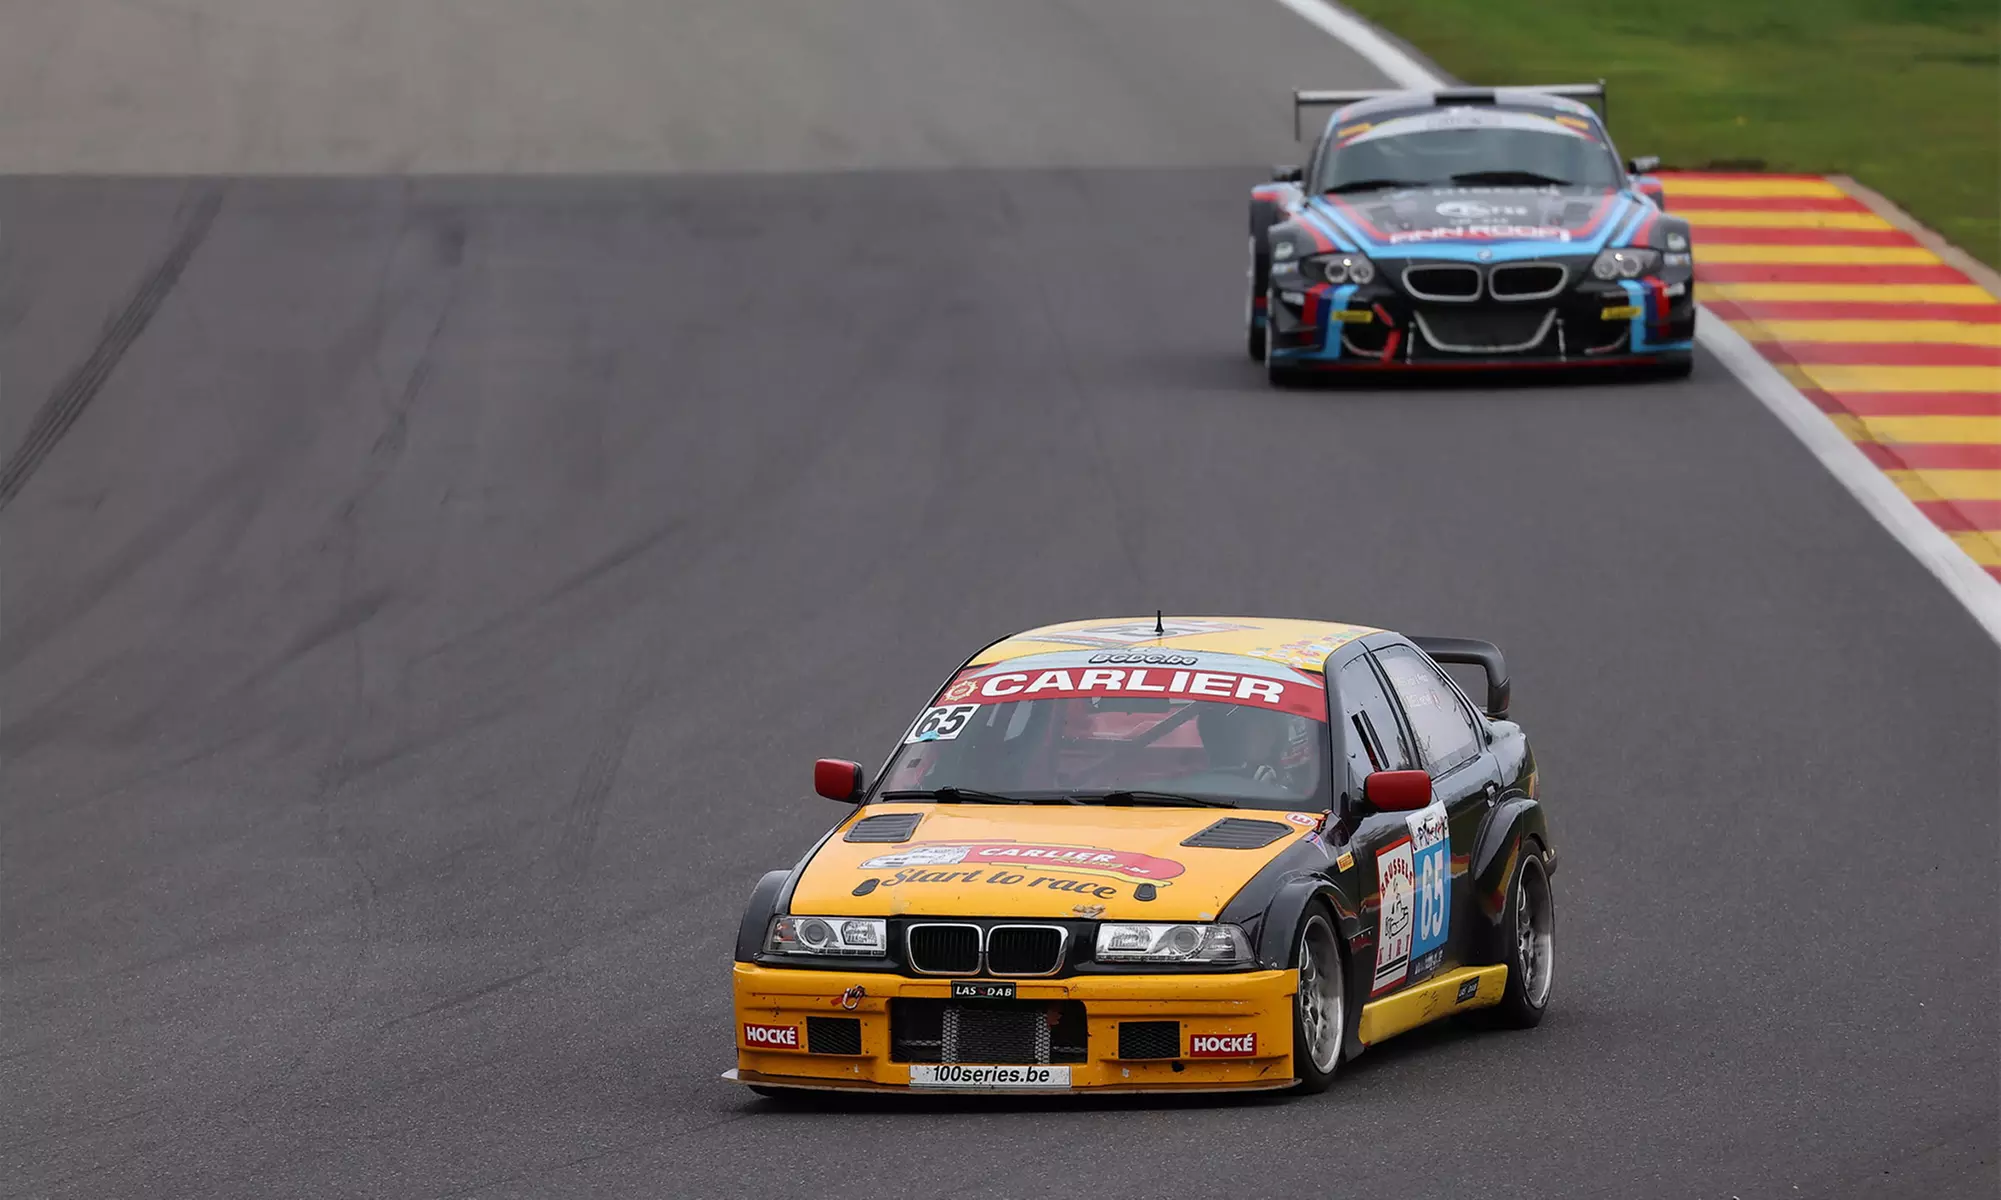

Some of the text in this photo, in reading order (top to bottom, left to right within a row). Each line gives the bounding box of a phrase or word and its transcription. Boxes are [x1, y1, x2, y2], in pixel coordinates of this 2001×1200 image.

[980, 668, 1285, 704] CARLIER
[914, 705, 975, 738] 65
[979, 848, 1117, 863] CARLIER
[881, 868, 1117, 899] Start to race
[1380, 857, 1414, 897] BRUSSELS
[1420, 849, 1444, 941] 65
[956, 985, 1012, 997] LAS DAB
[746, 1026, 797, 1045] HOCKÉ
[1193, 1032, 1253, 1052] HOCKÉ
[933, 1065, 1050, 1083] 100series.be
